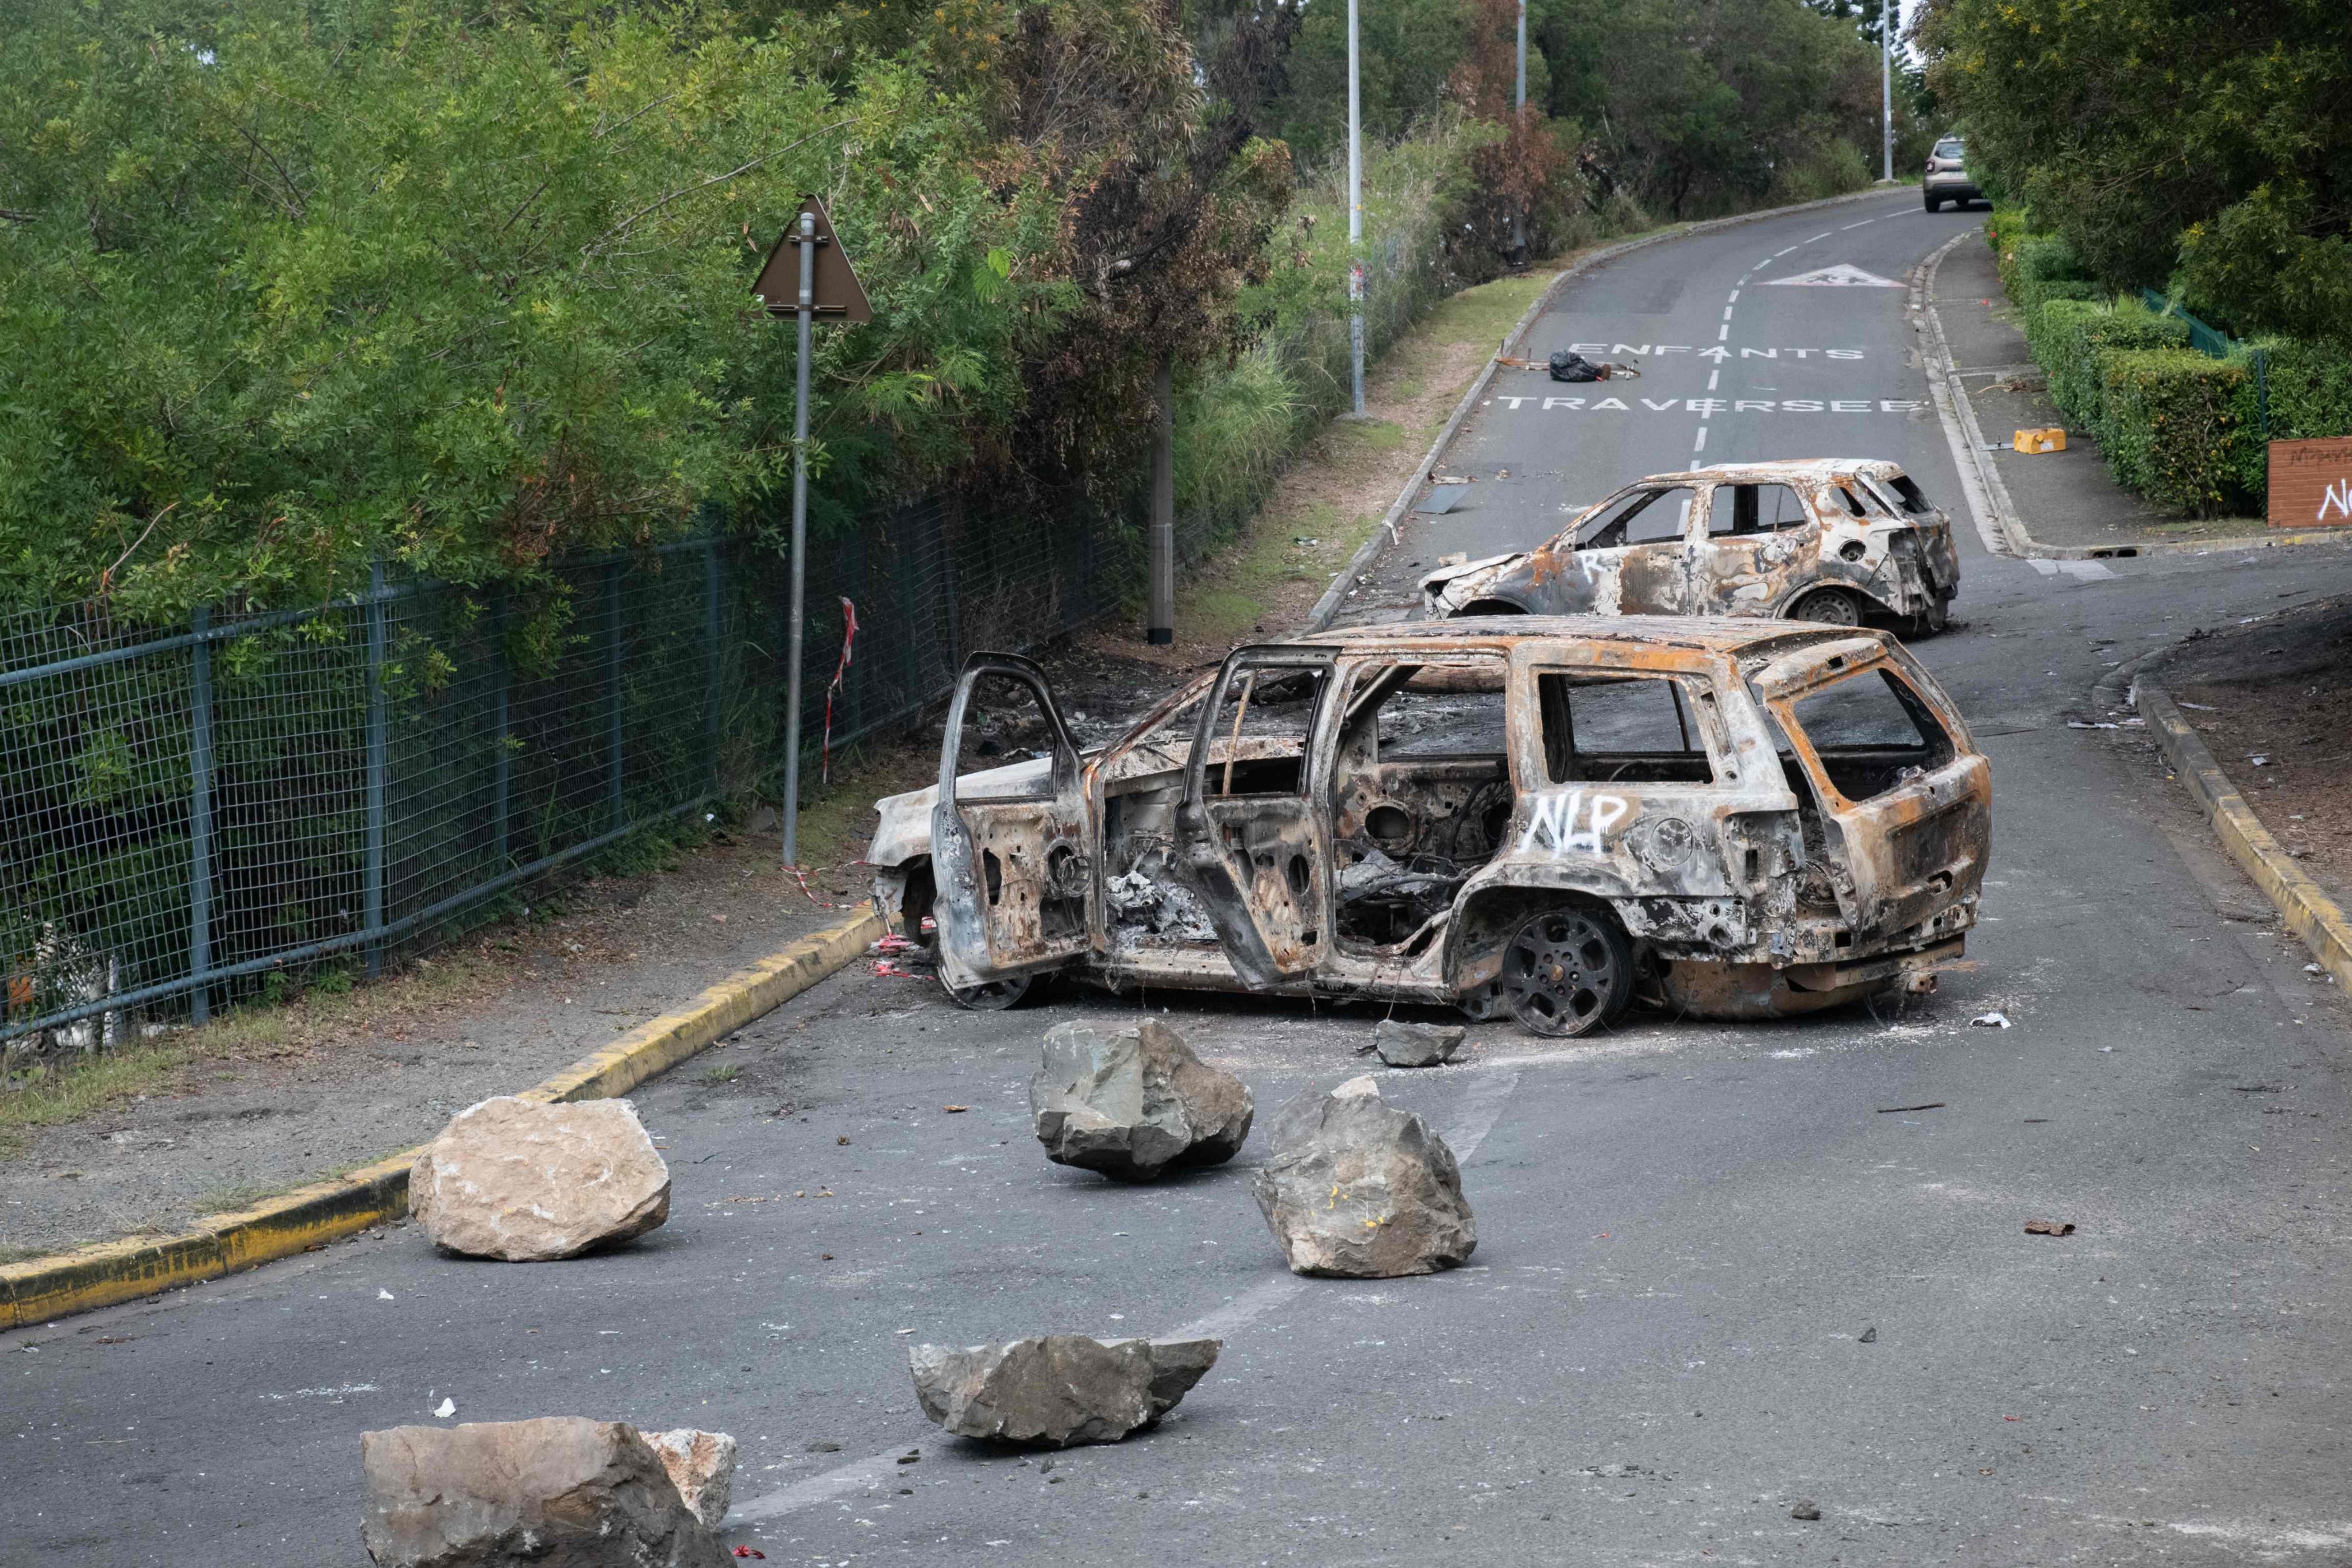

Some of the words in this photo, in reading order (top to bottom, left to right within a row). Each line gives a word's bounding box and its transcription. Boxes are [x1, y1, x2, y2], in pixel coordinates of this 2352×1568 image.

[1568, 343, 1864, 360] ENFANTS
[2316, 478, 2352, 520] N
[1517, 791, 1628, 860] NLP
